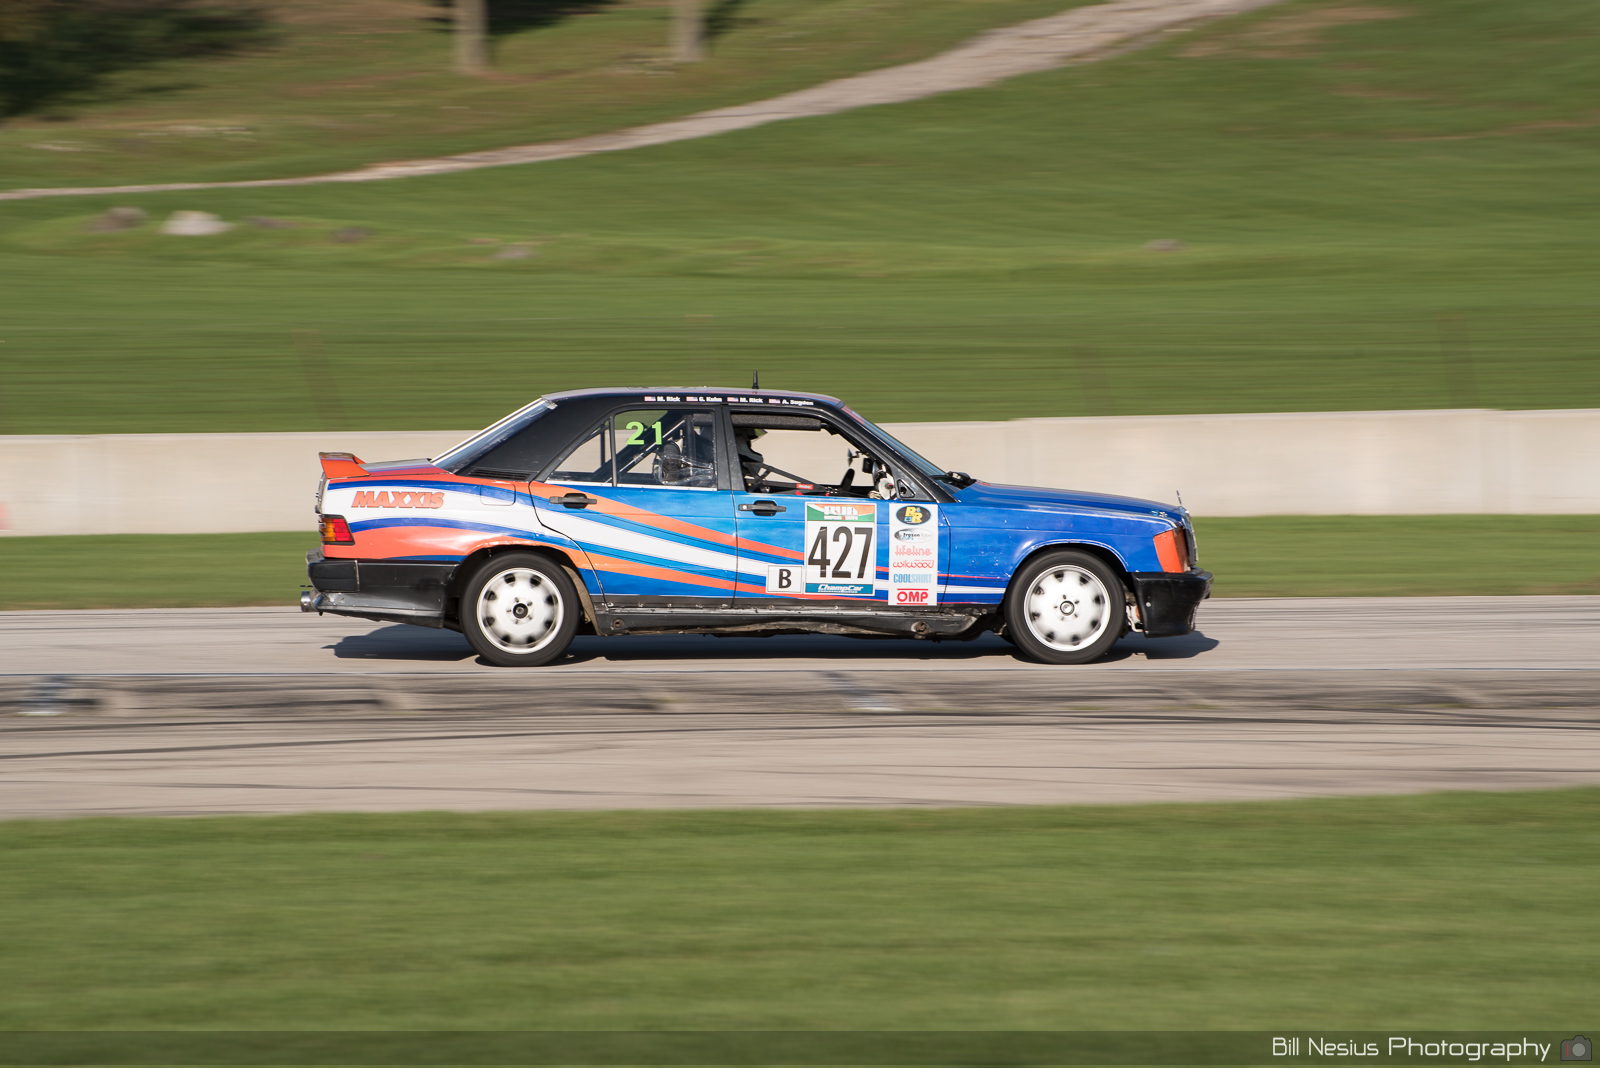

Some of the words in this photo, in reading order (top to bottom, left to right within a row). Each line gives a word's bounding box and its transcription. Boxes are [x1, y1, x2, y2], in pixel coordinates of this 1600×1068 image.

[625, 421, 662, 445] 21
[351, 491, 445, 509] MAXXIS
[808, 526, 873, 578] 427
[895, 545, 932, 556] lifeline
[778, 568, 792, 589] B
[893, 573, 932, 583] COOLSHIRT
[818, 584, 864, 593] ChampCar
[897, 591, 928, 602] OMP
